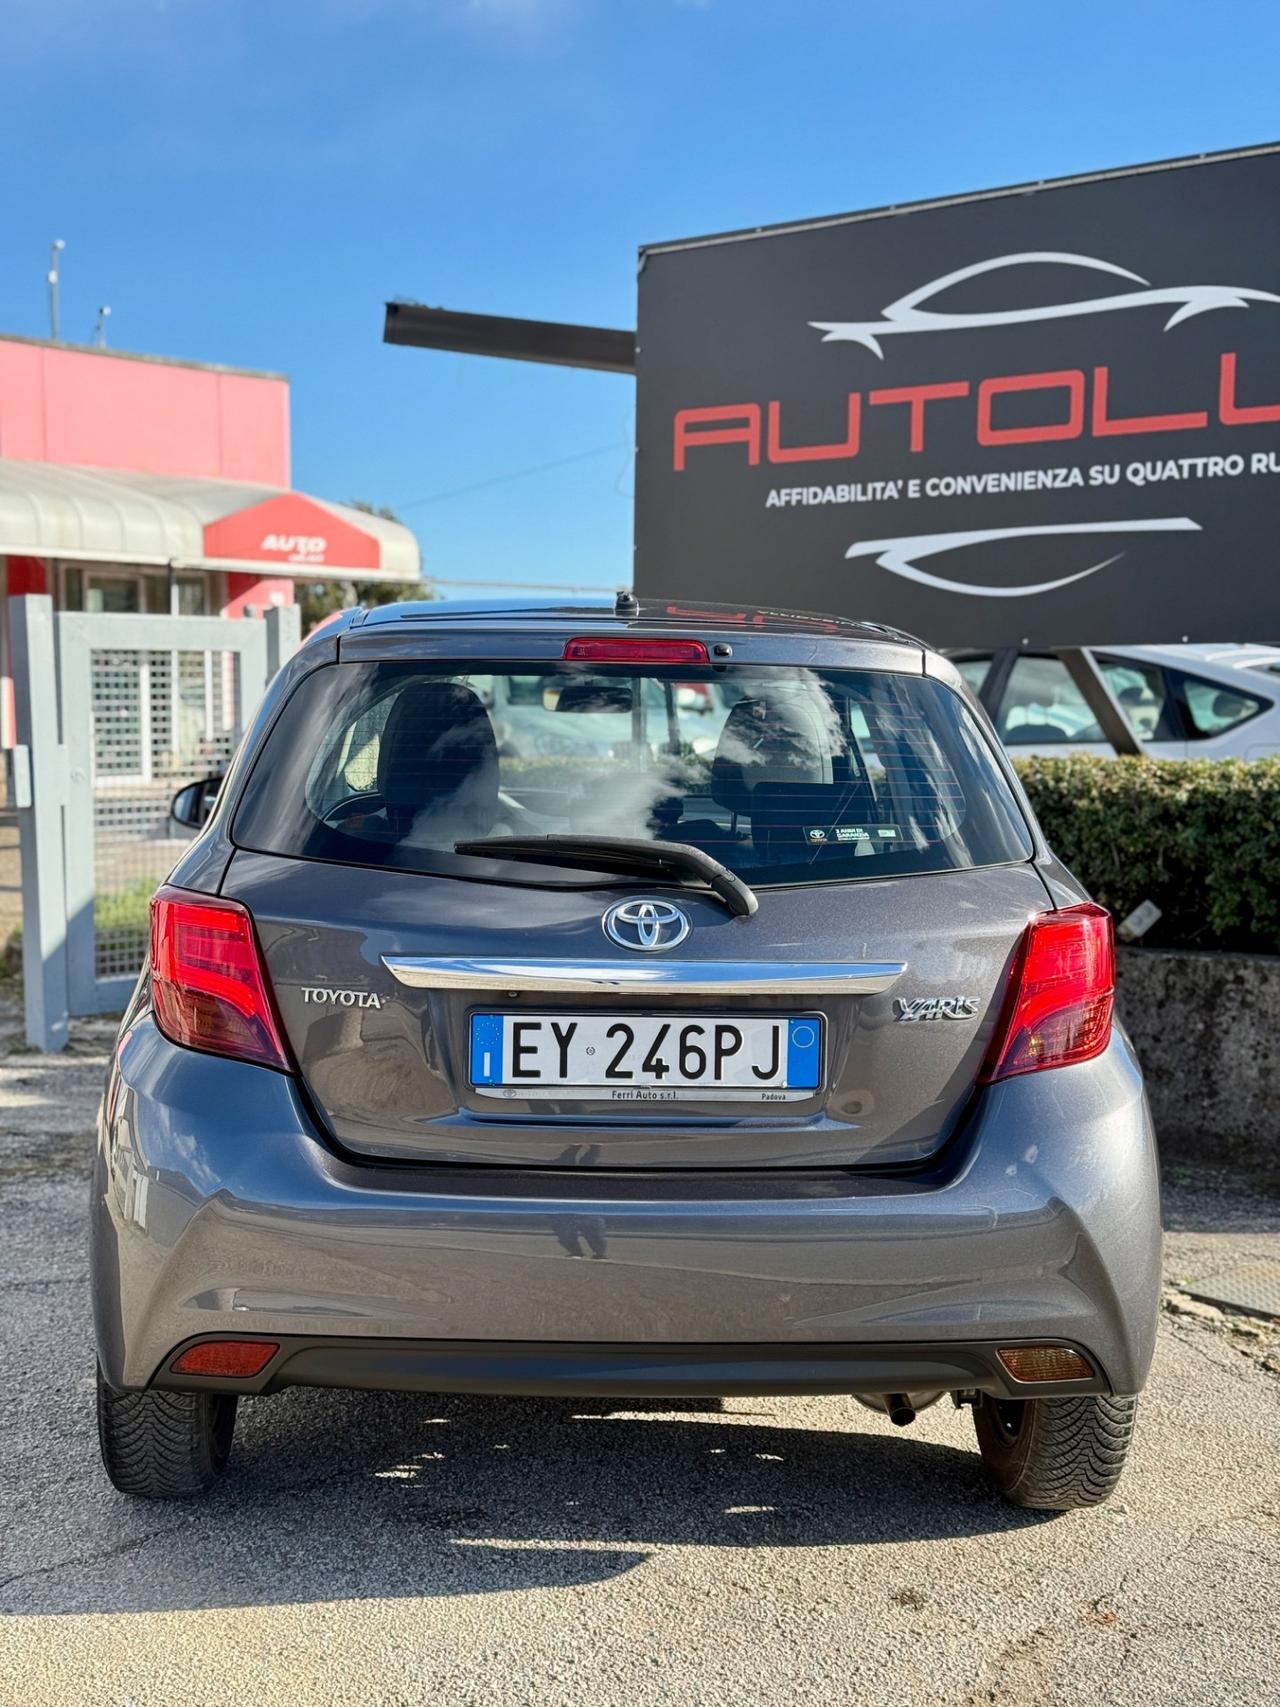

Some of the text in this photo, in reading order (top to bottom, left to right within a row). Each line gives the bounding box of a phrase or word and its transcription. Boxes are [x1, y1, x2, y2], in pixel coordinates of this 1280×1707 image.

[765, 479, 903, 508] AFFIDABILITA'
[907, 478, 921, 499] E
[925, 467, 1085, 497] CONVENIENZA
[1088, 463, 1121, 486] SU
[1125, 454, 1245, 486] QUATTRO
[261, 534, 327, 552] AUTO
[301, 987, 381, 1009] TOYOTA
[512, 1022, 578, 1079] EY
[611, 1090, 634, 1099] Ferri
[635, 1090, 658, 1100] Auto
[761, 1092, 786, 1100] Padova
